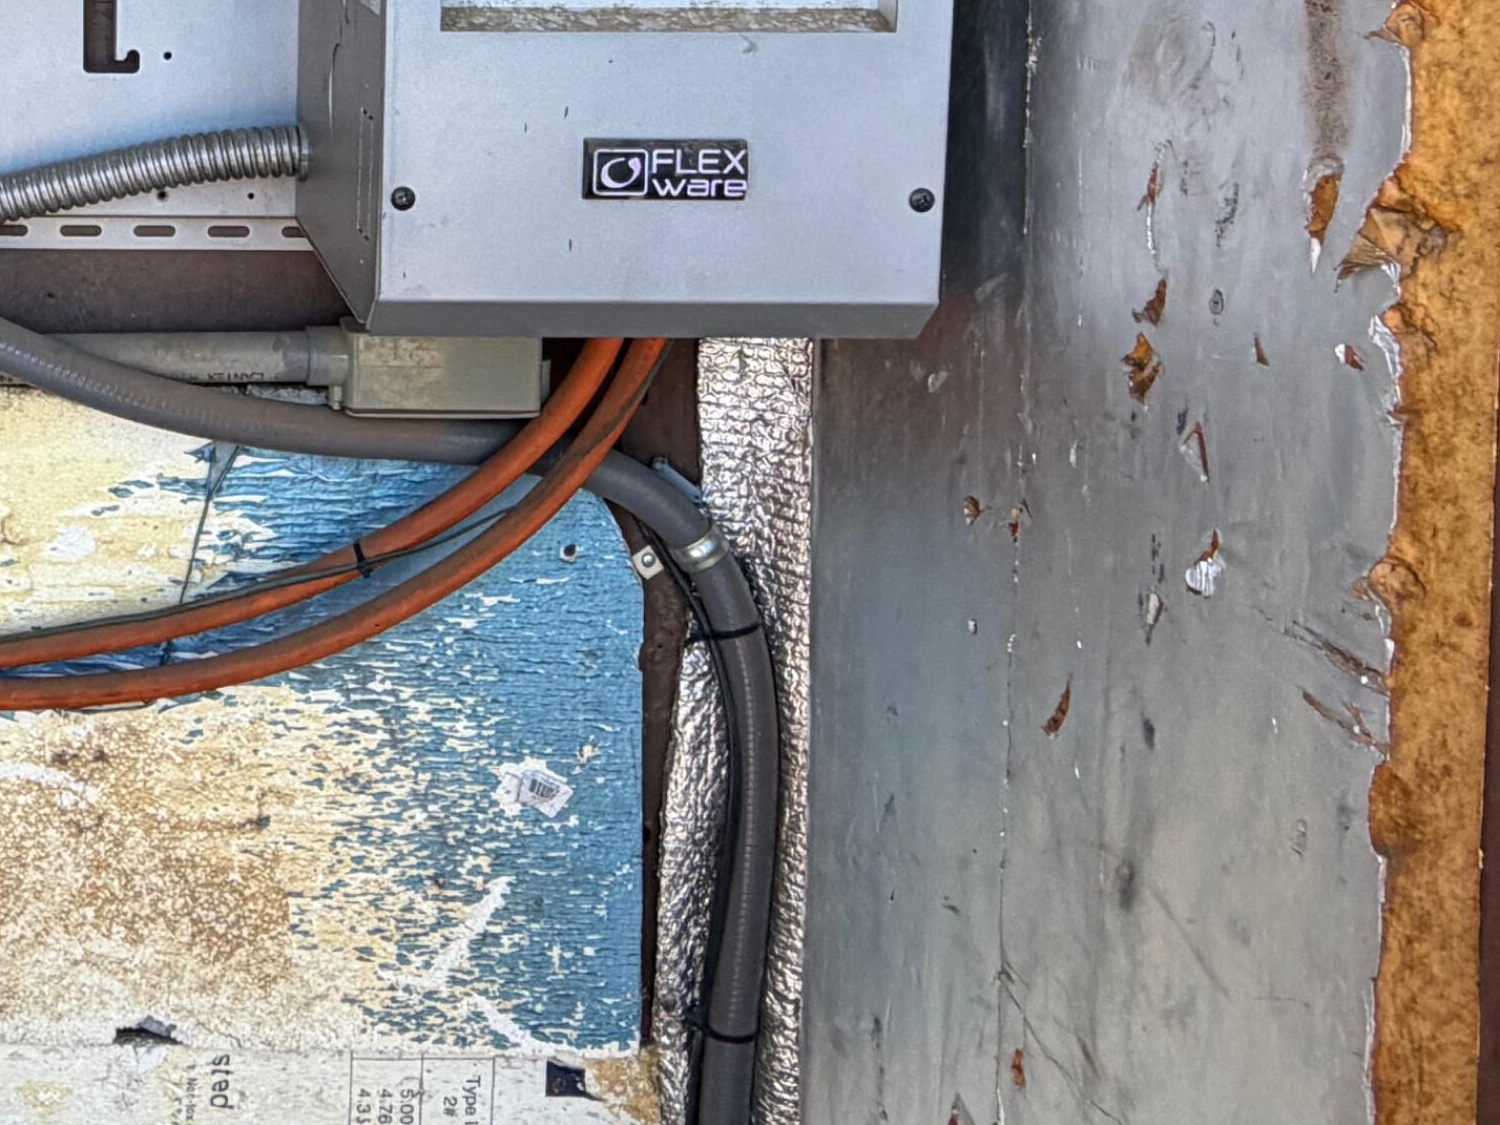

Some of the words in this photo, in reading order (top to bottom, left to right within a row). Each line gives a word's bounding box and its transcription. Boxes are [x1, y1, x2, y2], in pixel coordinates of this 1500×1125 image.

[651, 149, 747, 174] FLEX
[651, 179, 748, 197] ware
[377, 1088, 393, 1125] 4.76
[443, 1096, 458, 1118] 2#
[461, 1076, 482, 1117] Type
